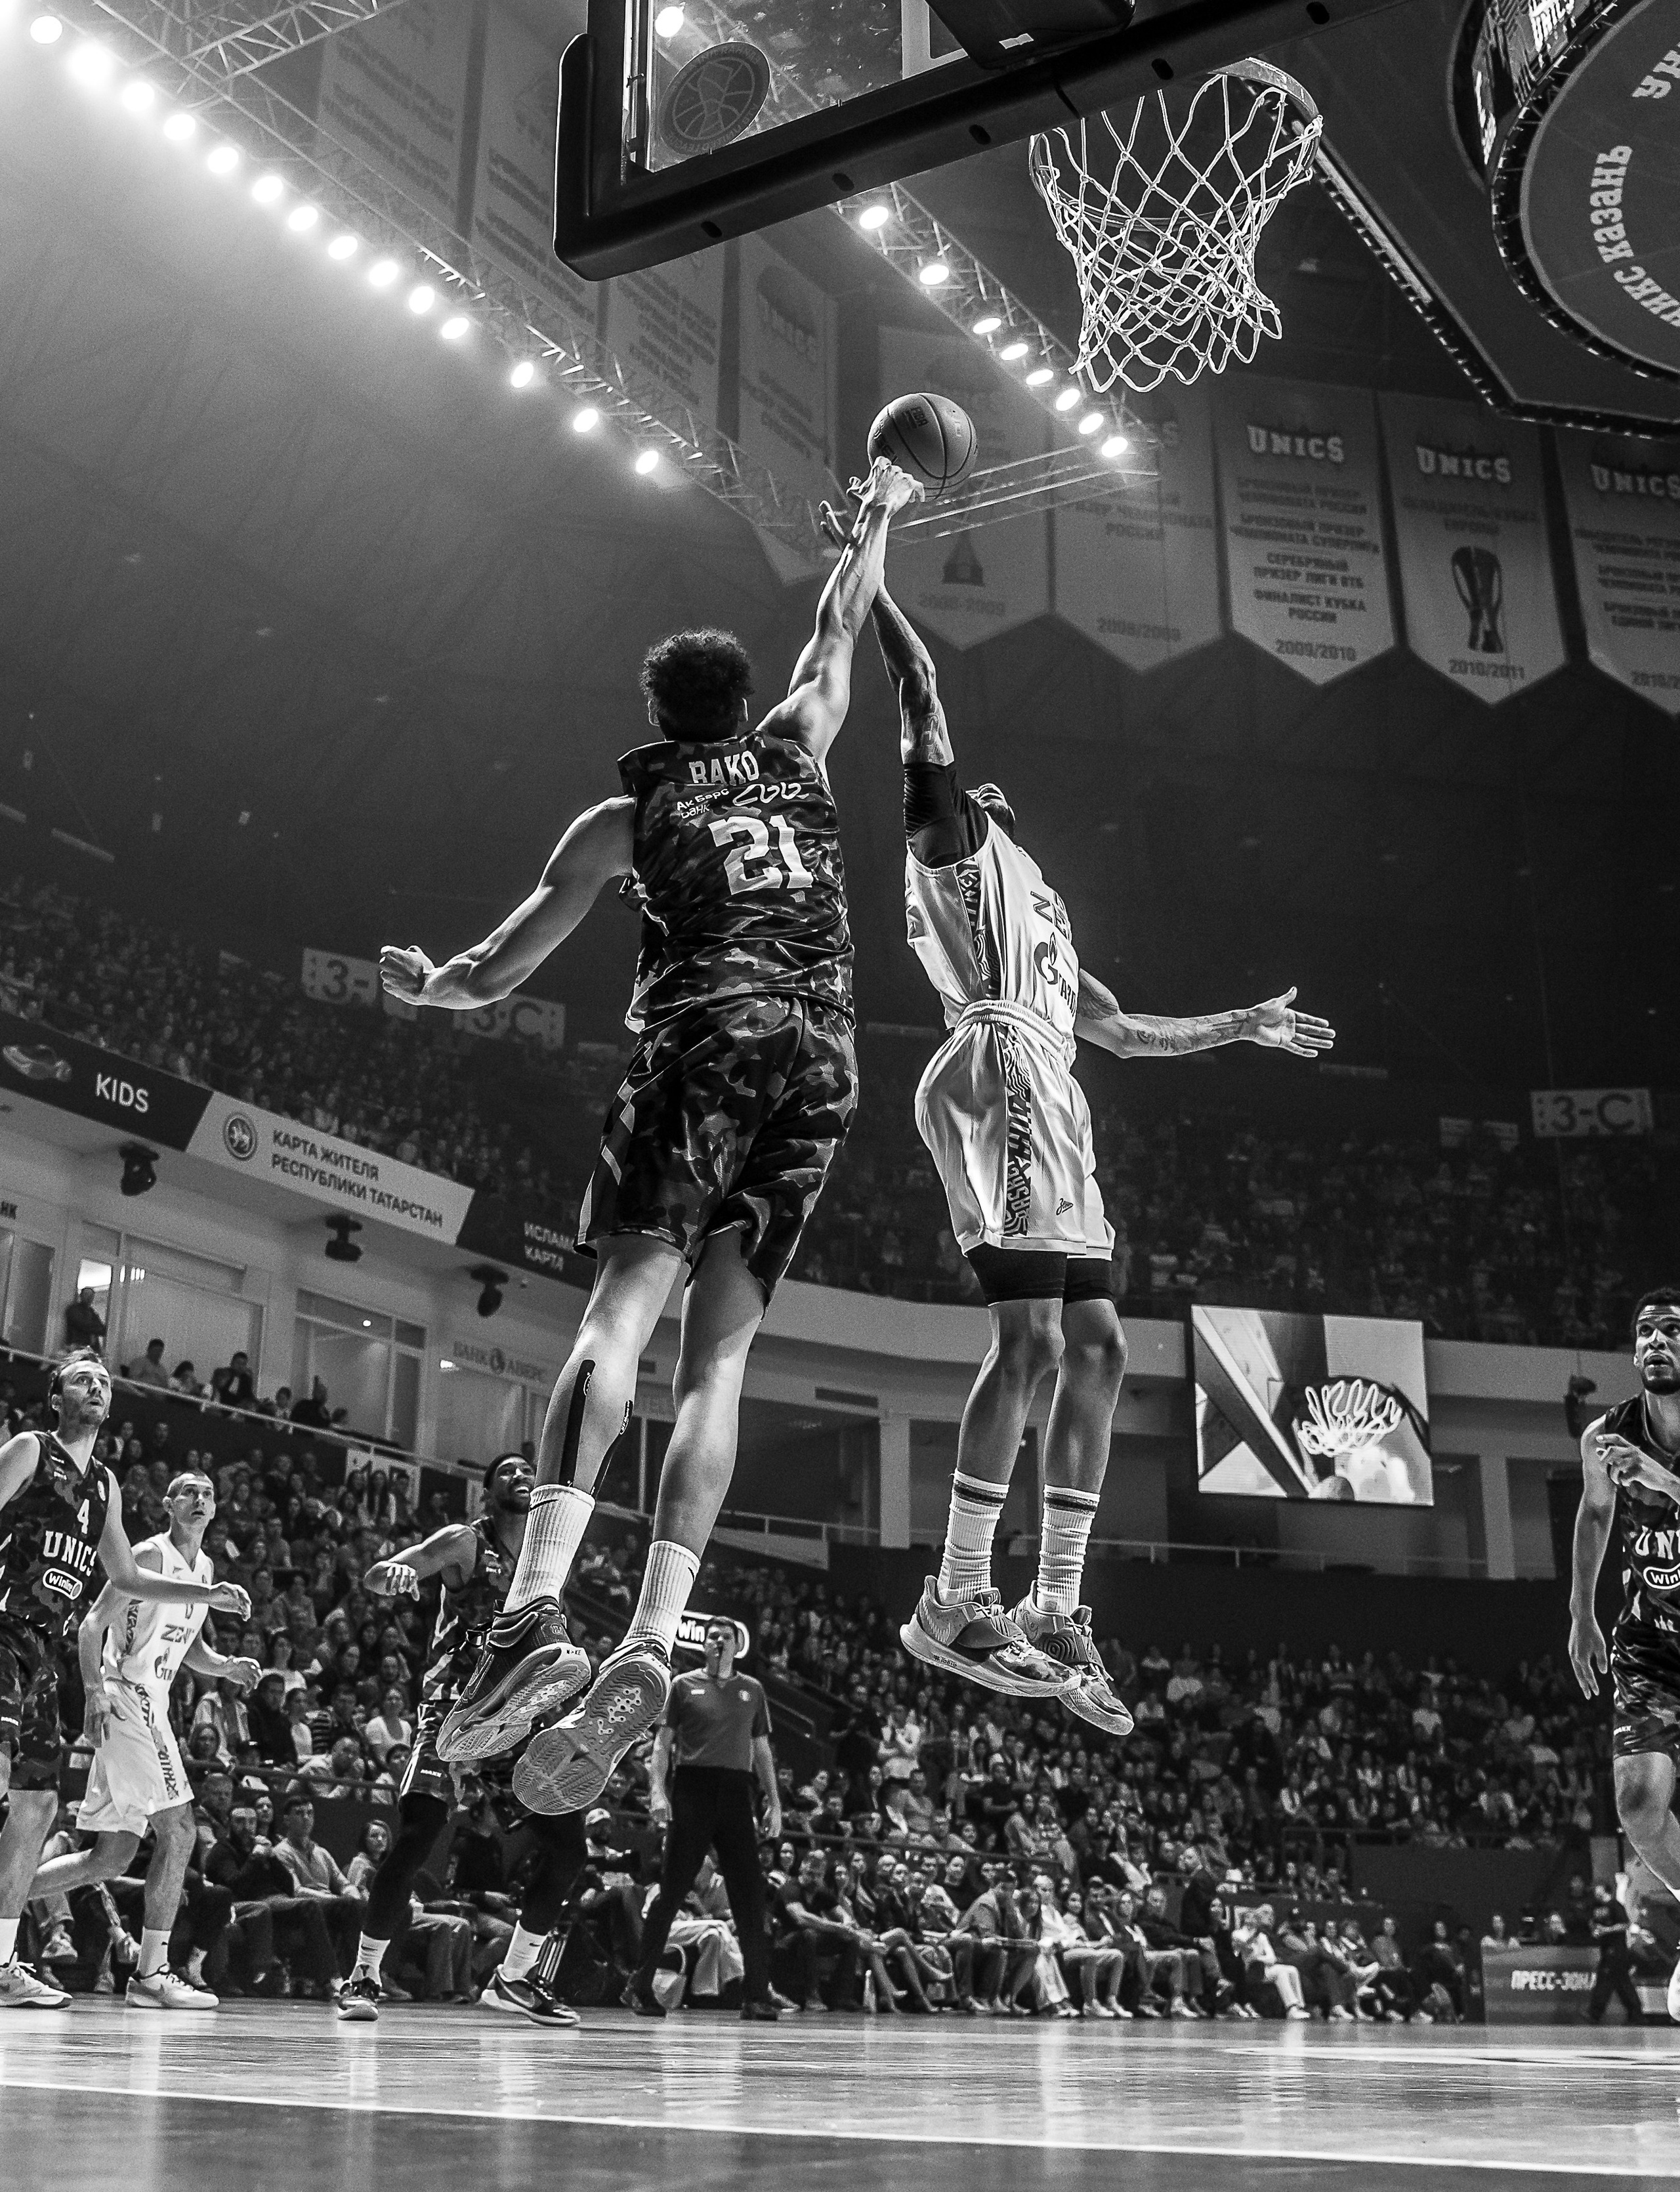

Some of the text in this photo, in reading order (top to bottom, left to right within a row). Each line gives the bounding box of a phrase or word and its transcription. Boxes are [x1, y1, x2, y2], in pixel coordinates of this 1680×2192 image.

[1631, 42, 1680, 99] УН
[1247, 425, 1345, 463] UNICS
[1415, 446, 1512, 484] UNICS
[1276, 638, 1357, 662] 2009/2010
[1449, 658, 1526, 681] 2010/2011
[708, 814, 814, 895] 21
[94, 1072, 150, 1112] KIDS
[272, 1129, 381, 1182] КАРТА ЖИТЕЛЯ
[270, 1154, 444, 1229] РЕСПУБЛИКИ ТАТАРСТАН
[524, 1245, 564, 1271] КАРТА
[77, 1498, 90, 1534] 4
